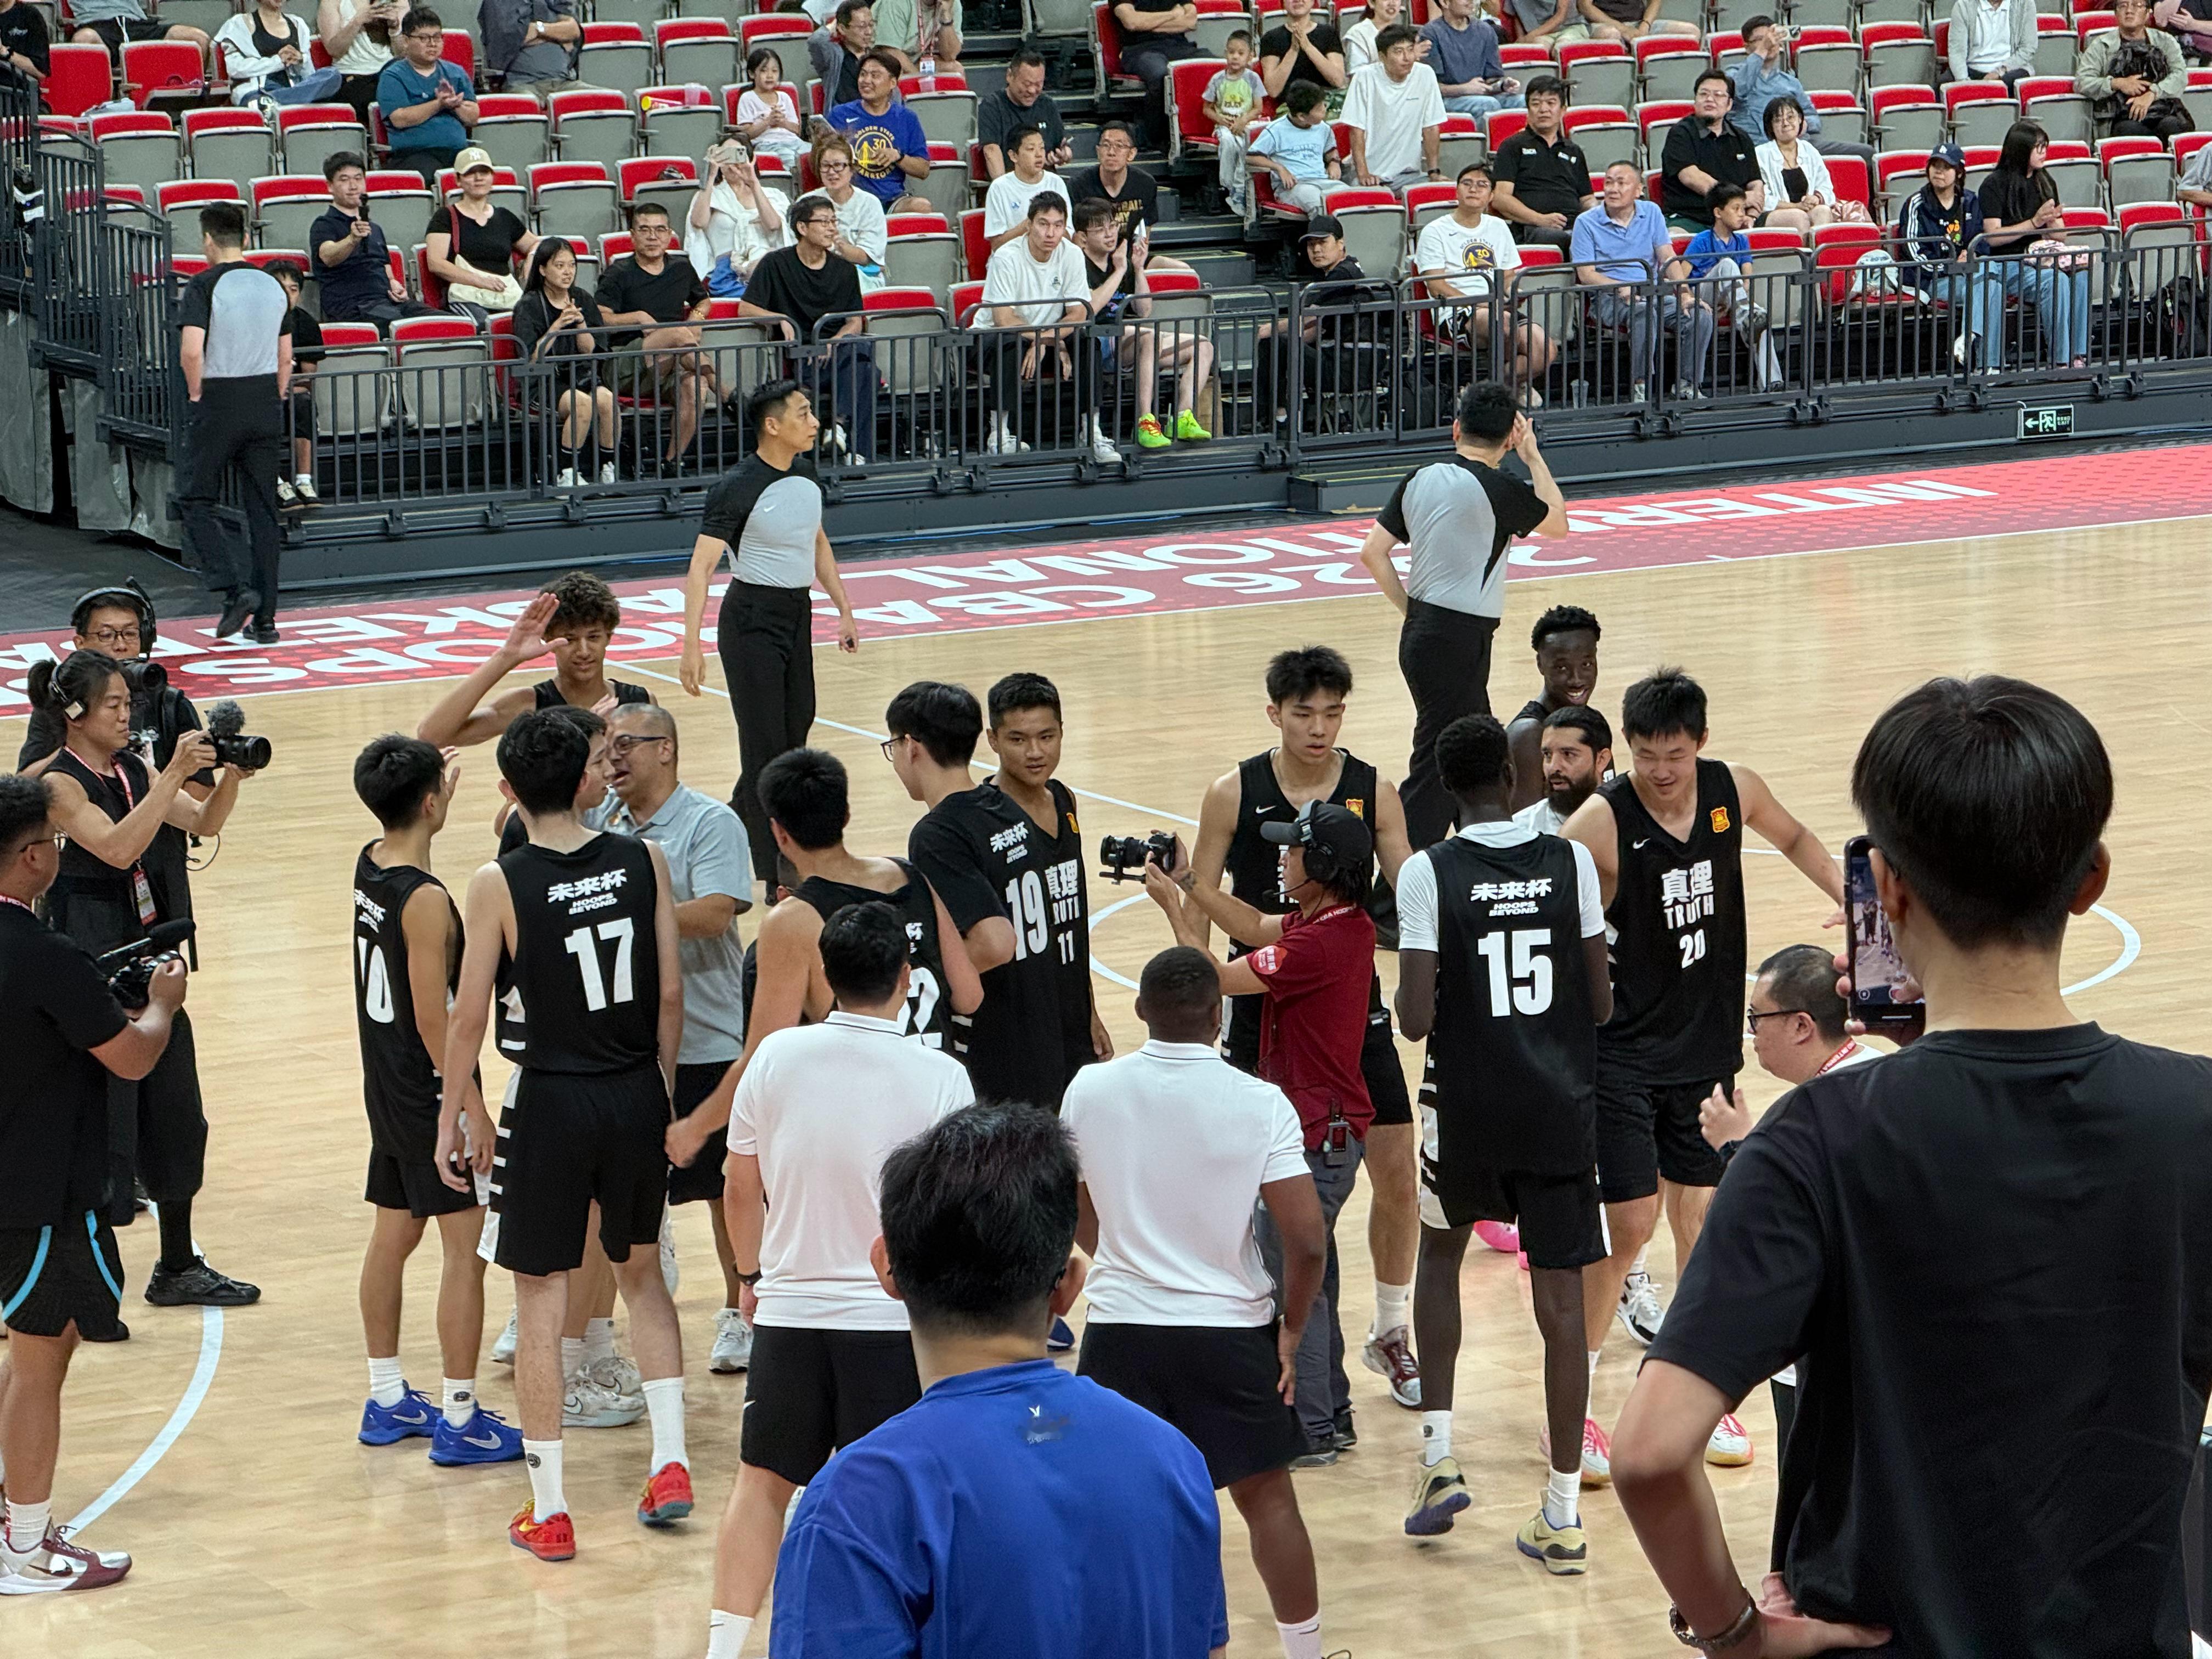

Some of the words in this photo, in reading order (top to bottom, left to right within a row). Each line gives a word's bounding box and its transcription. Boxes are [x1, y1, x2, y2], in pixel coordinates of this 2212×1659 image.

[873, 138, 886, 150] 30
[1475, 249, 1490, 258] 30
[811, 585, 1156, 625] CBA
[989, 821, 1029, 853] 未来杯
[548, 868, 627, 904] 未来杯
[1045, 859, 1079, 900] 真理
[1470, 878, 1552, 901] 未来杯
[1662, 859, 1714, 907] 真理
[568, 898, 618, 915] BEYOND
[572, 893, 614, 908] HOOPS
[1005, 870, 1048, 961] 19
[1488, 907, 1539, 917] BEYOND
[1493, 901, 1536, 910] HOOPS
[1664, 894, 1714, 929] TRUTH
[564, 917, 634, 1012] 17
[1058, 930, 1075, 965] 11
[1679, 928, 1706, 969] 20
[358, 935, 394, 1023] 10
[1478, 928, 1553, 1017] 15
